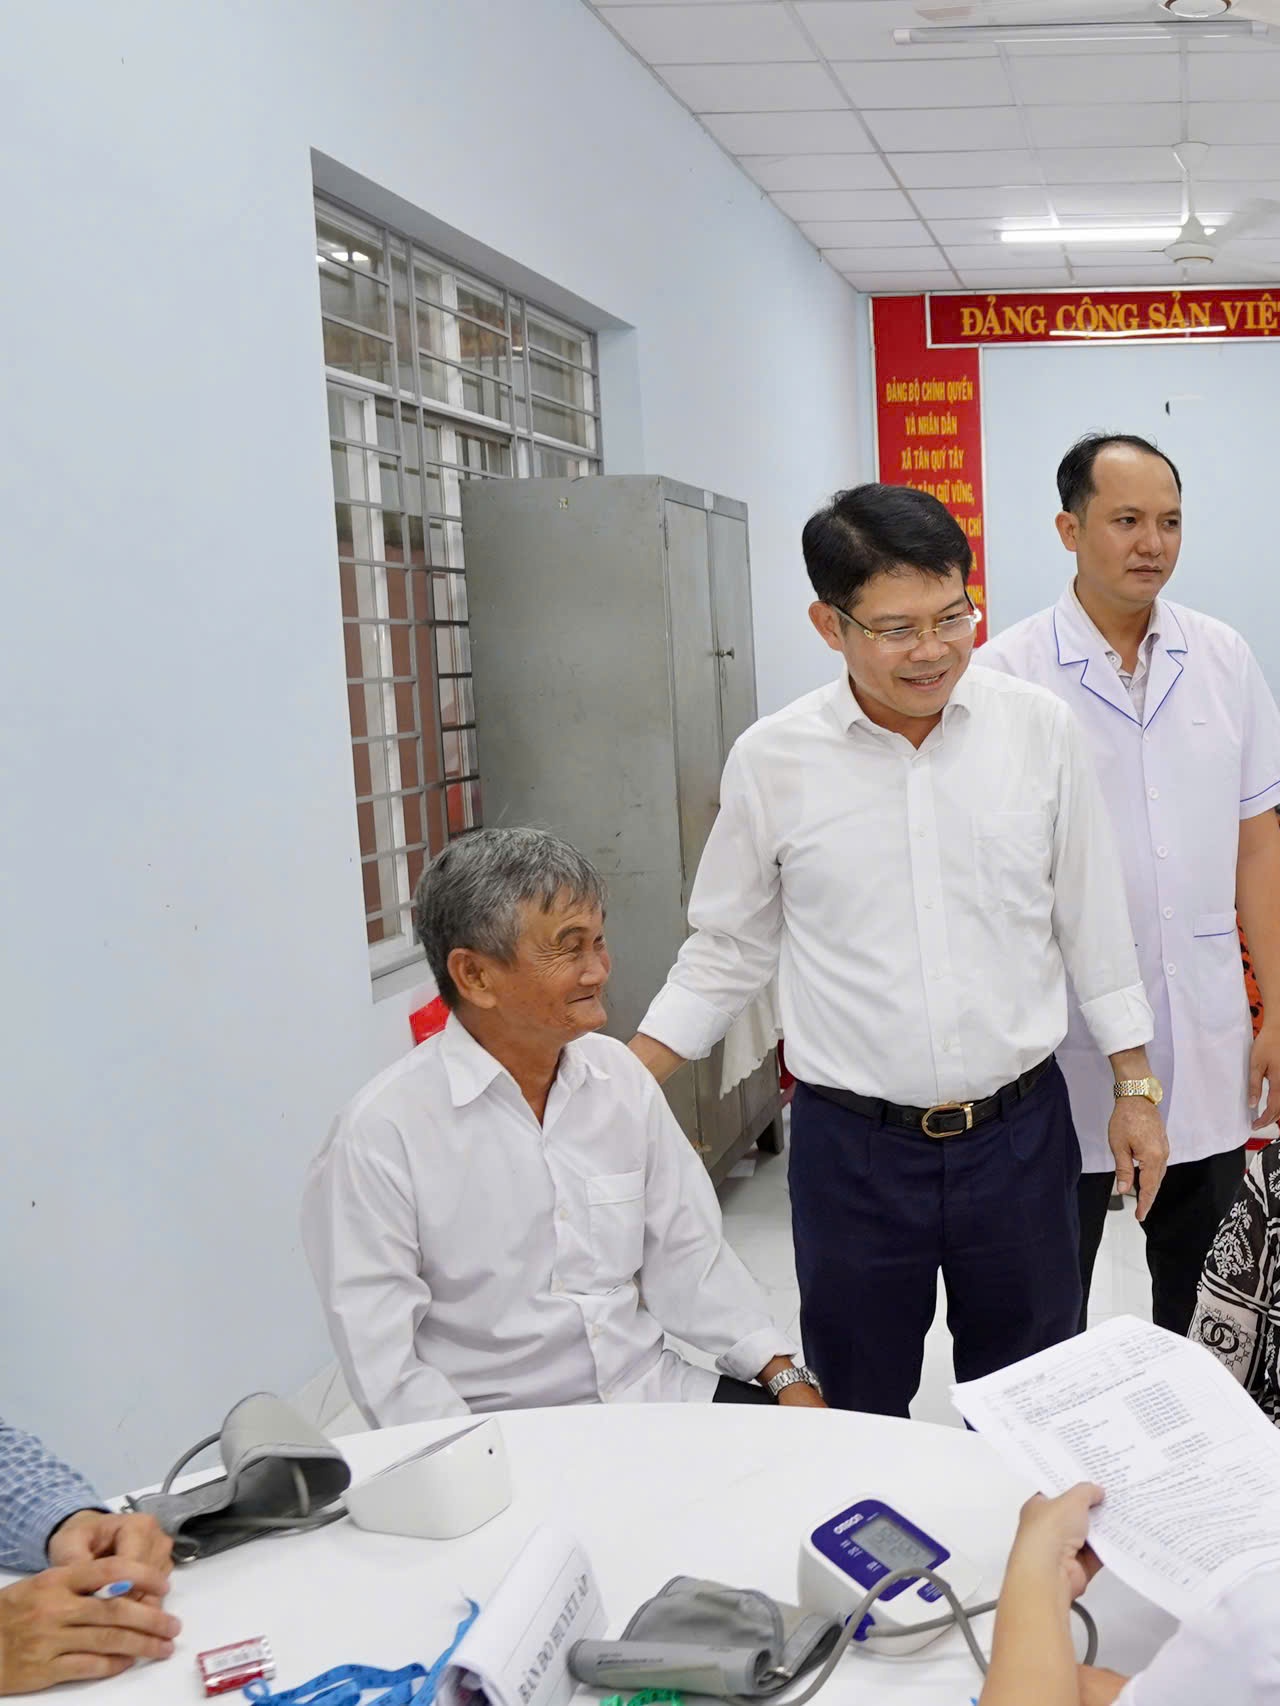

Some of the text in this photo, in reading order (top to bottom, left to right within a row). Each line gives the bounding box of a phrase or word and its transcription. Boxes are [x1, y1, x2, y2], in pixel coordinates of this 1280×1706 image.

[961, 295, 1047, 336] ĐẢNG
[1056, 296, 1140, 338] CỘNG
[1149, 291, 1213, 331] SẢN
